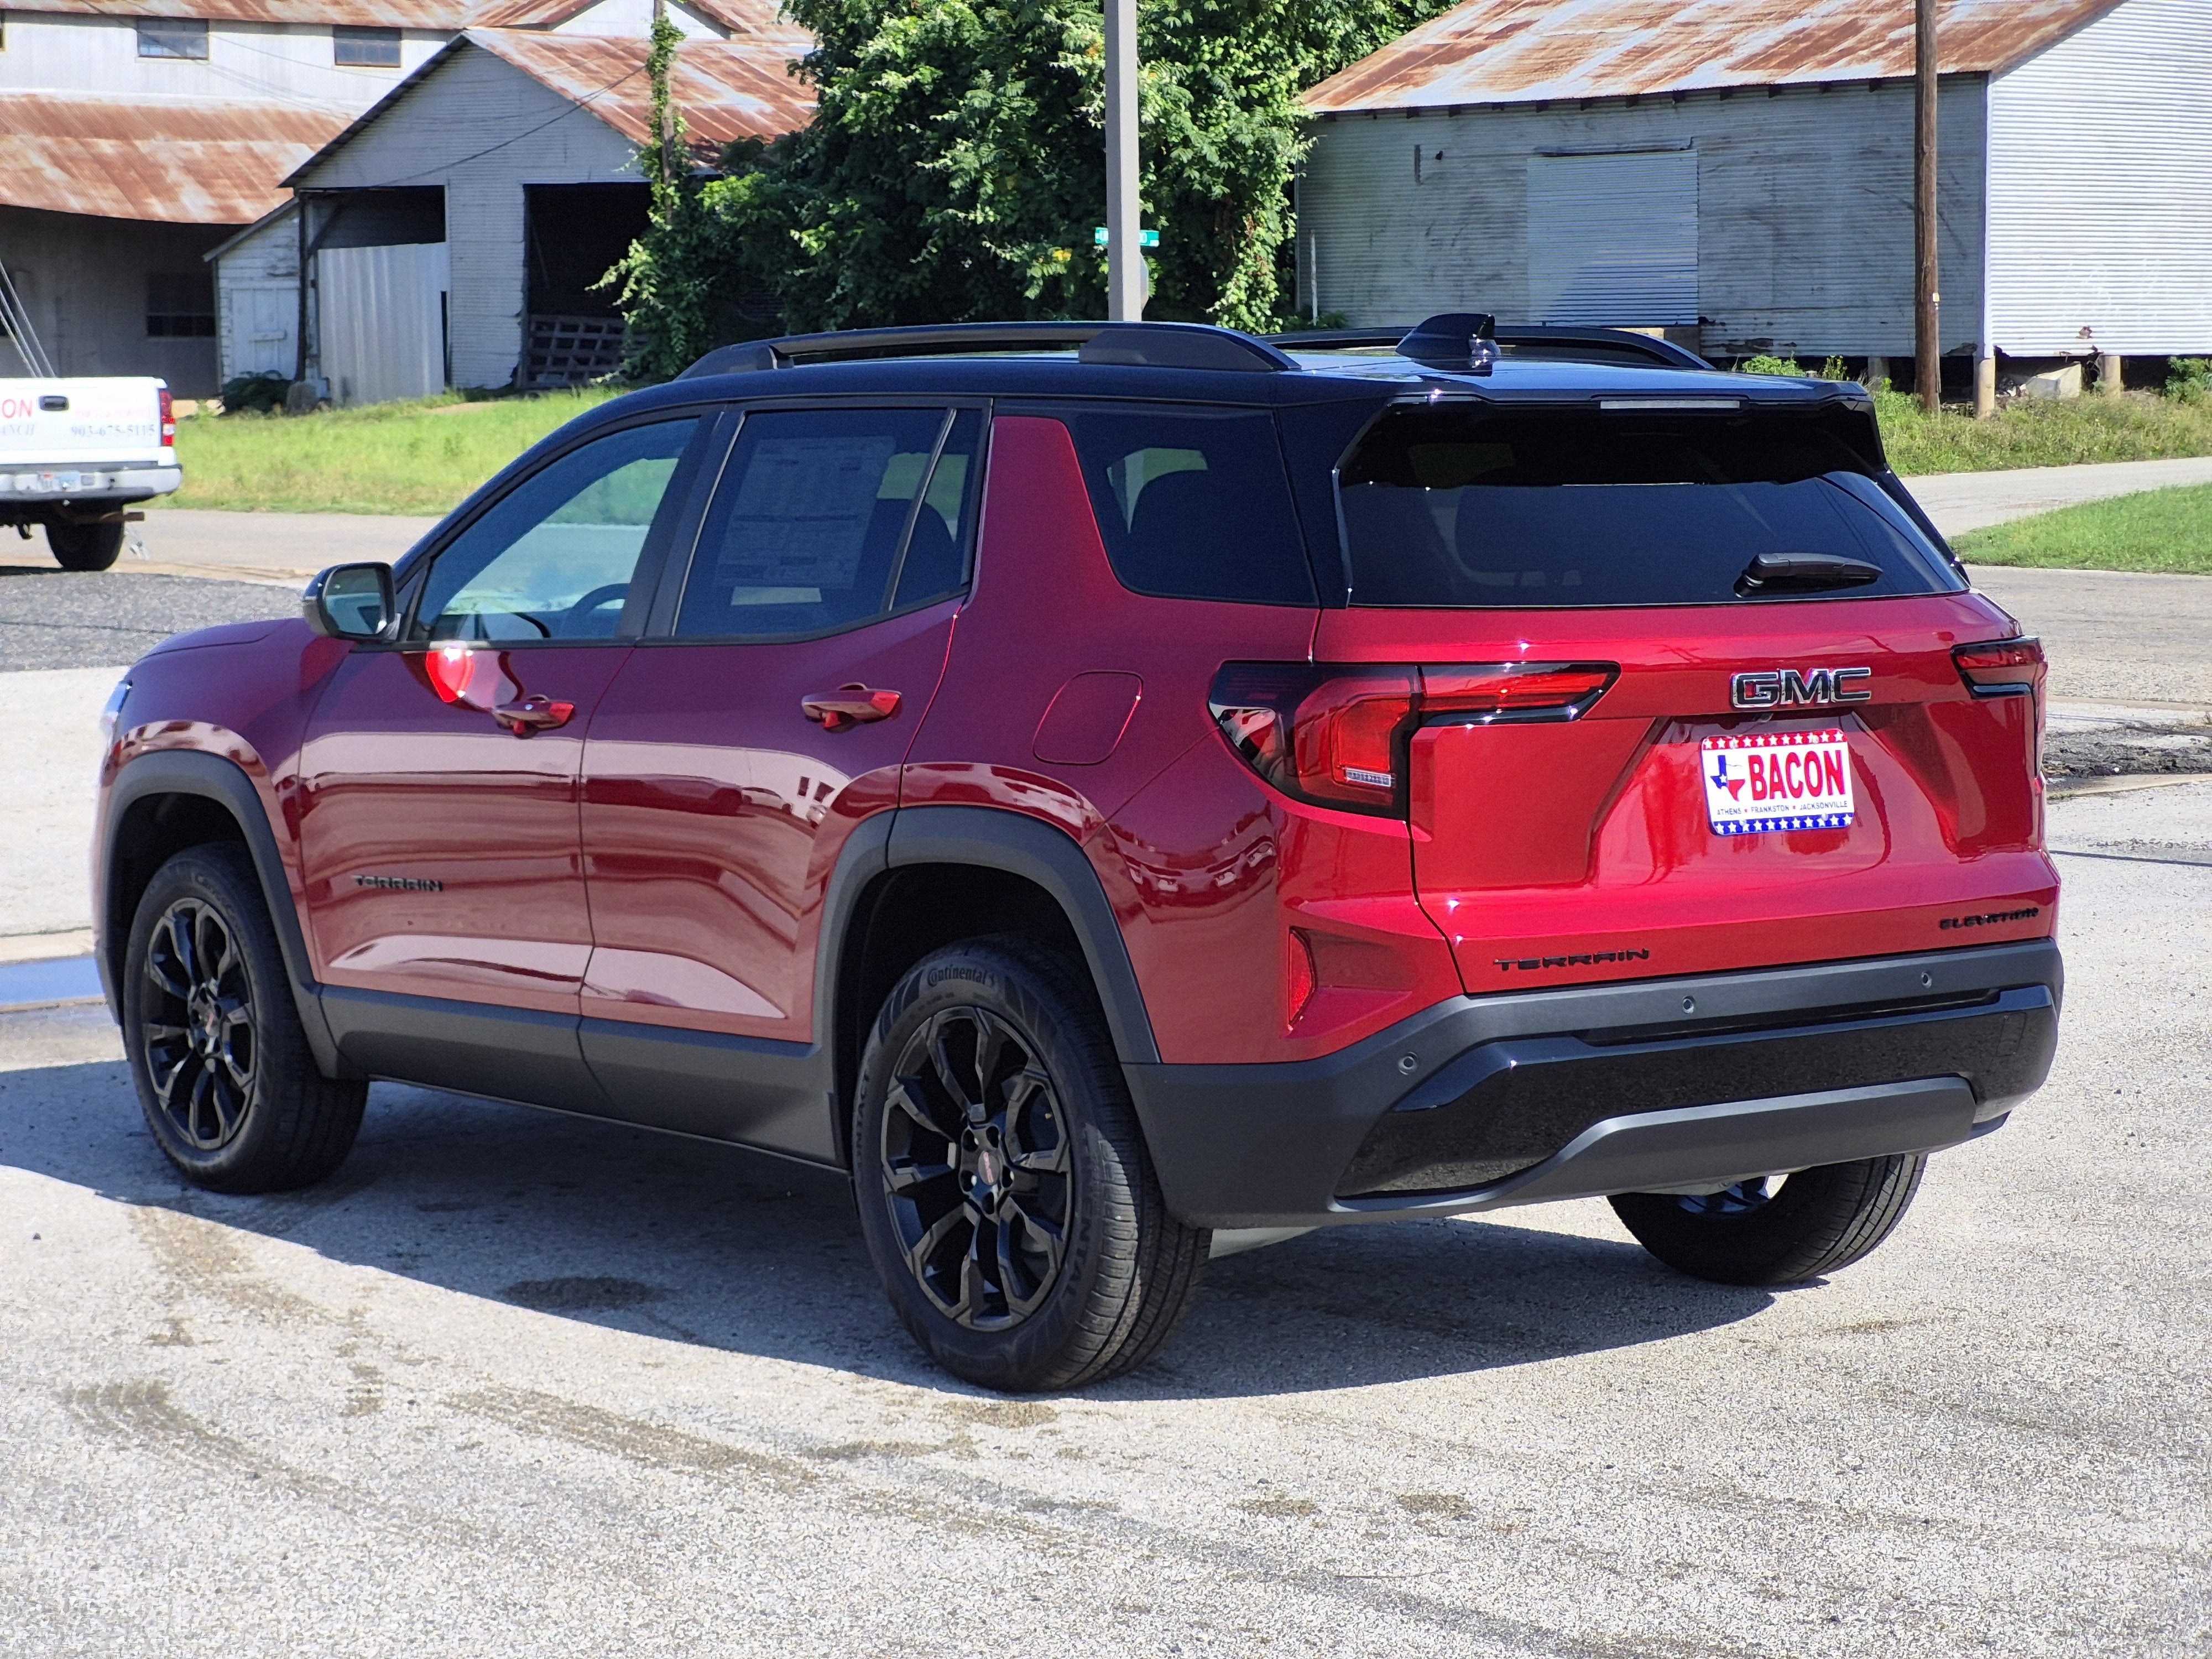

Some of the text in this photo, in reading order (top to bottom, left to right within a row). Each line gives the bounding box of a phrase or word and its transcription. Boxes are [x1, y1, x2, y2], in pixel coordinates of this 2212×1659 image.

[2, 399, 33, 419] ON
[1731, 667, 1872, 708] GMC
[1747, 749, 1846, 801] BACON
[1717, 801, 1848, 816] ATHENS FRANKSTON JACKSONVILLE
[351, 874, 444, 893] TERRAIN
[1939, 907, 2039, 930] ELEVATION
[1493, 948, 1650, 972] TERRAIN
[927, 963, 987, 988] Continental
